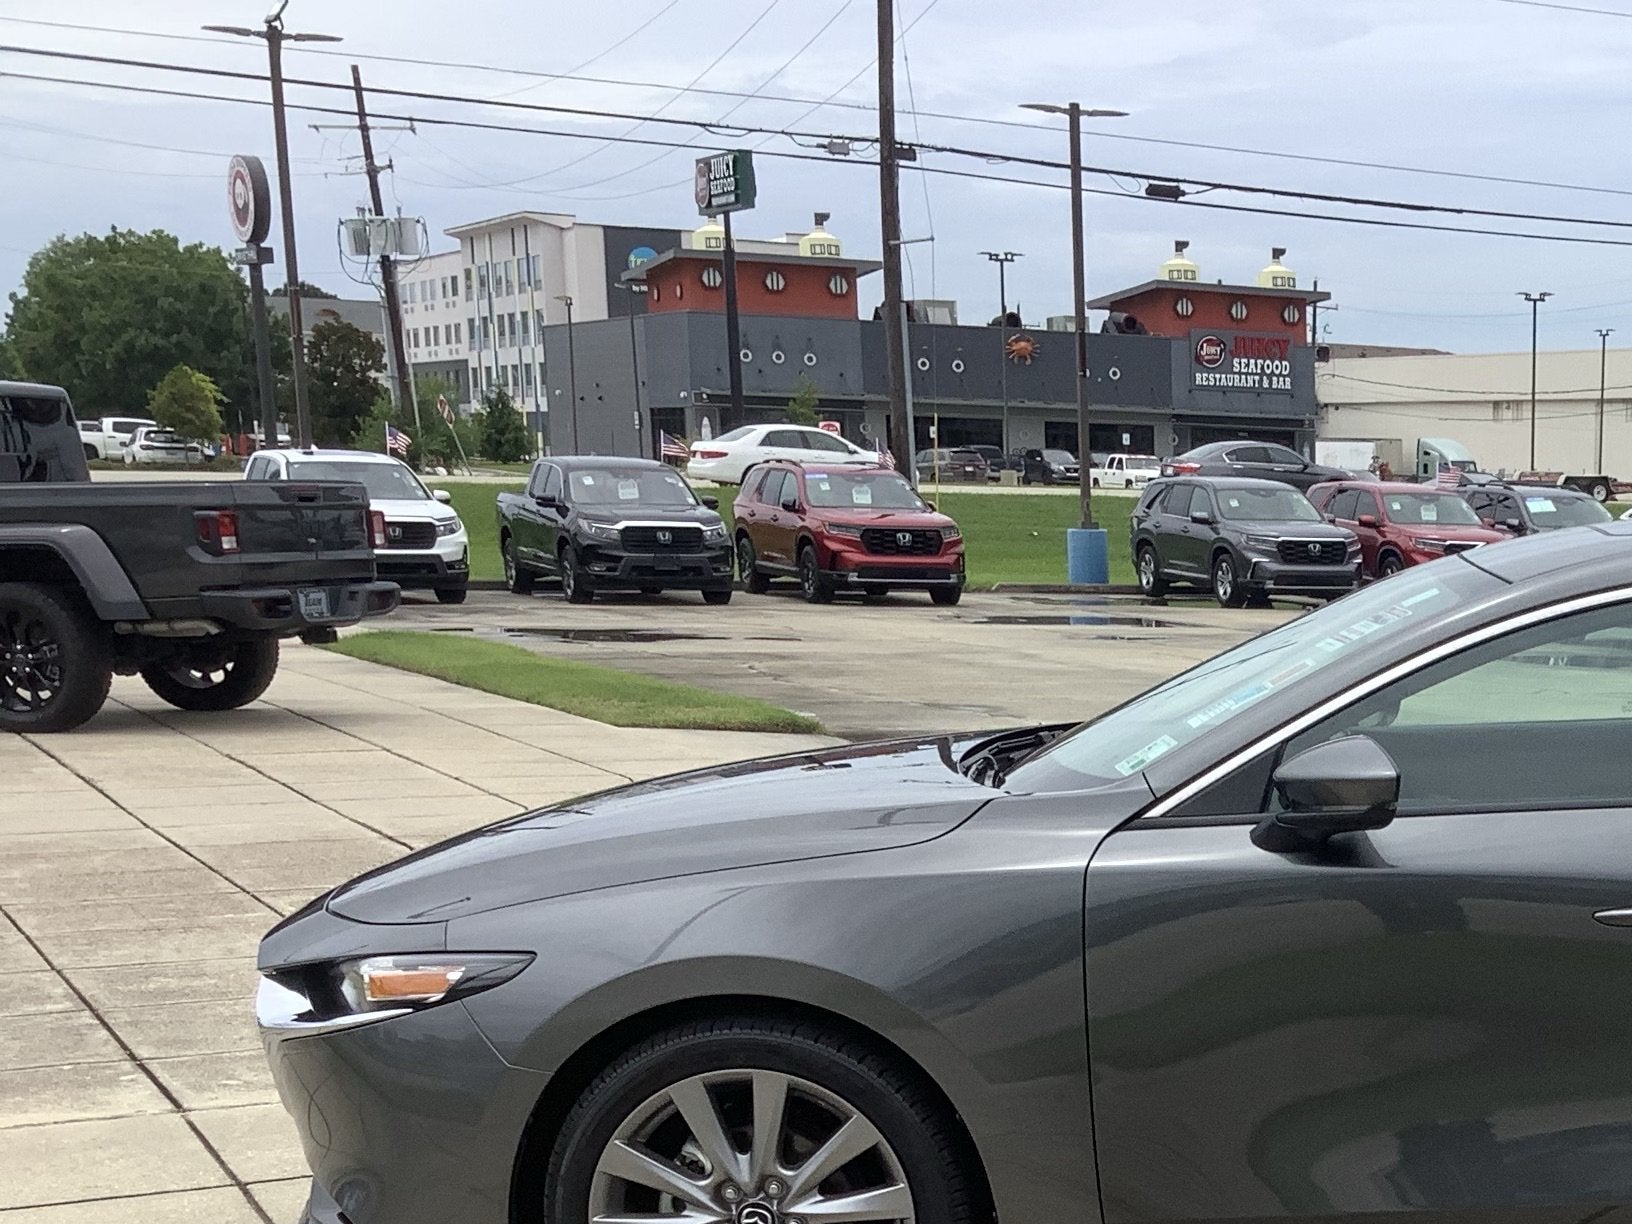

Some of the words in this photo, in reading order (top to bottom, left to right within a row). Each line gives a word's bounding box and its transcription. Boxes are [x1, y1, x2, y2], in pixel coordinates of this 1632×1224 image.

[709, 154, 735, 180] JUICY
[710, 177, 736, 195] SEAFOOD
[1230, 335, 1291, 360] JUICY
[1232, 358, 1290, 375] SEAFOOD
[1195, 373, 1260, 388] RESTAURANT
[1262, 376, 1269, 388] &
[1272, 377, 1292, 390] BAR
